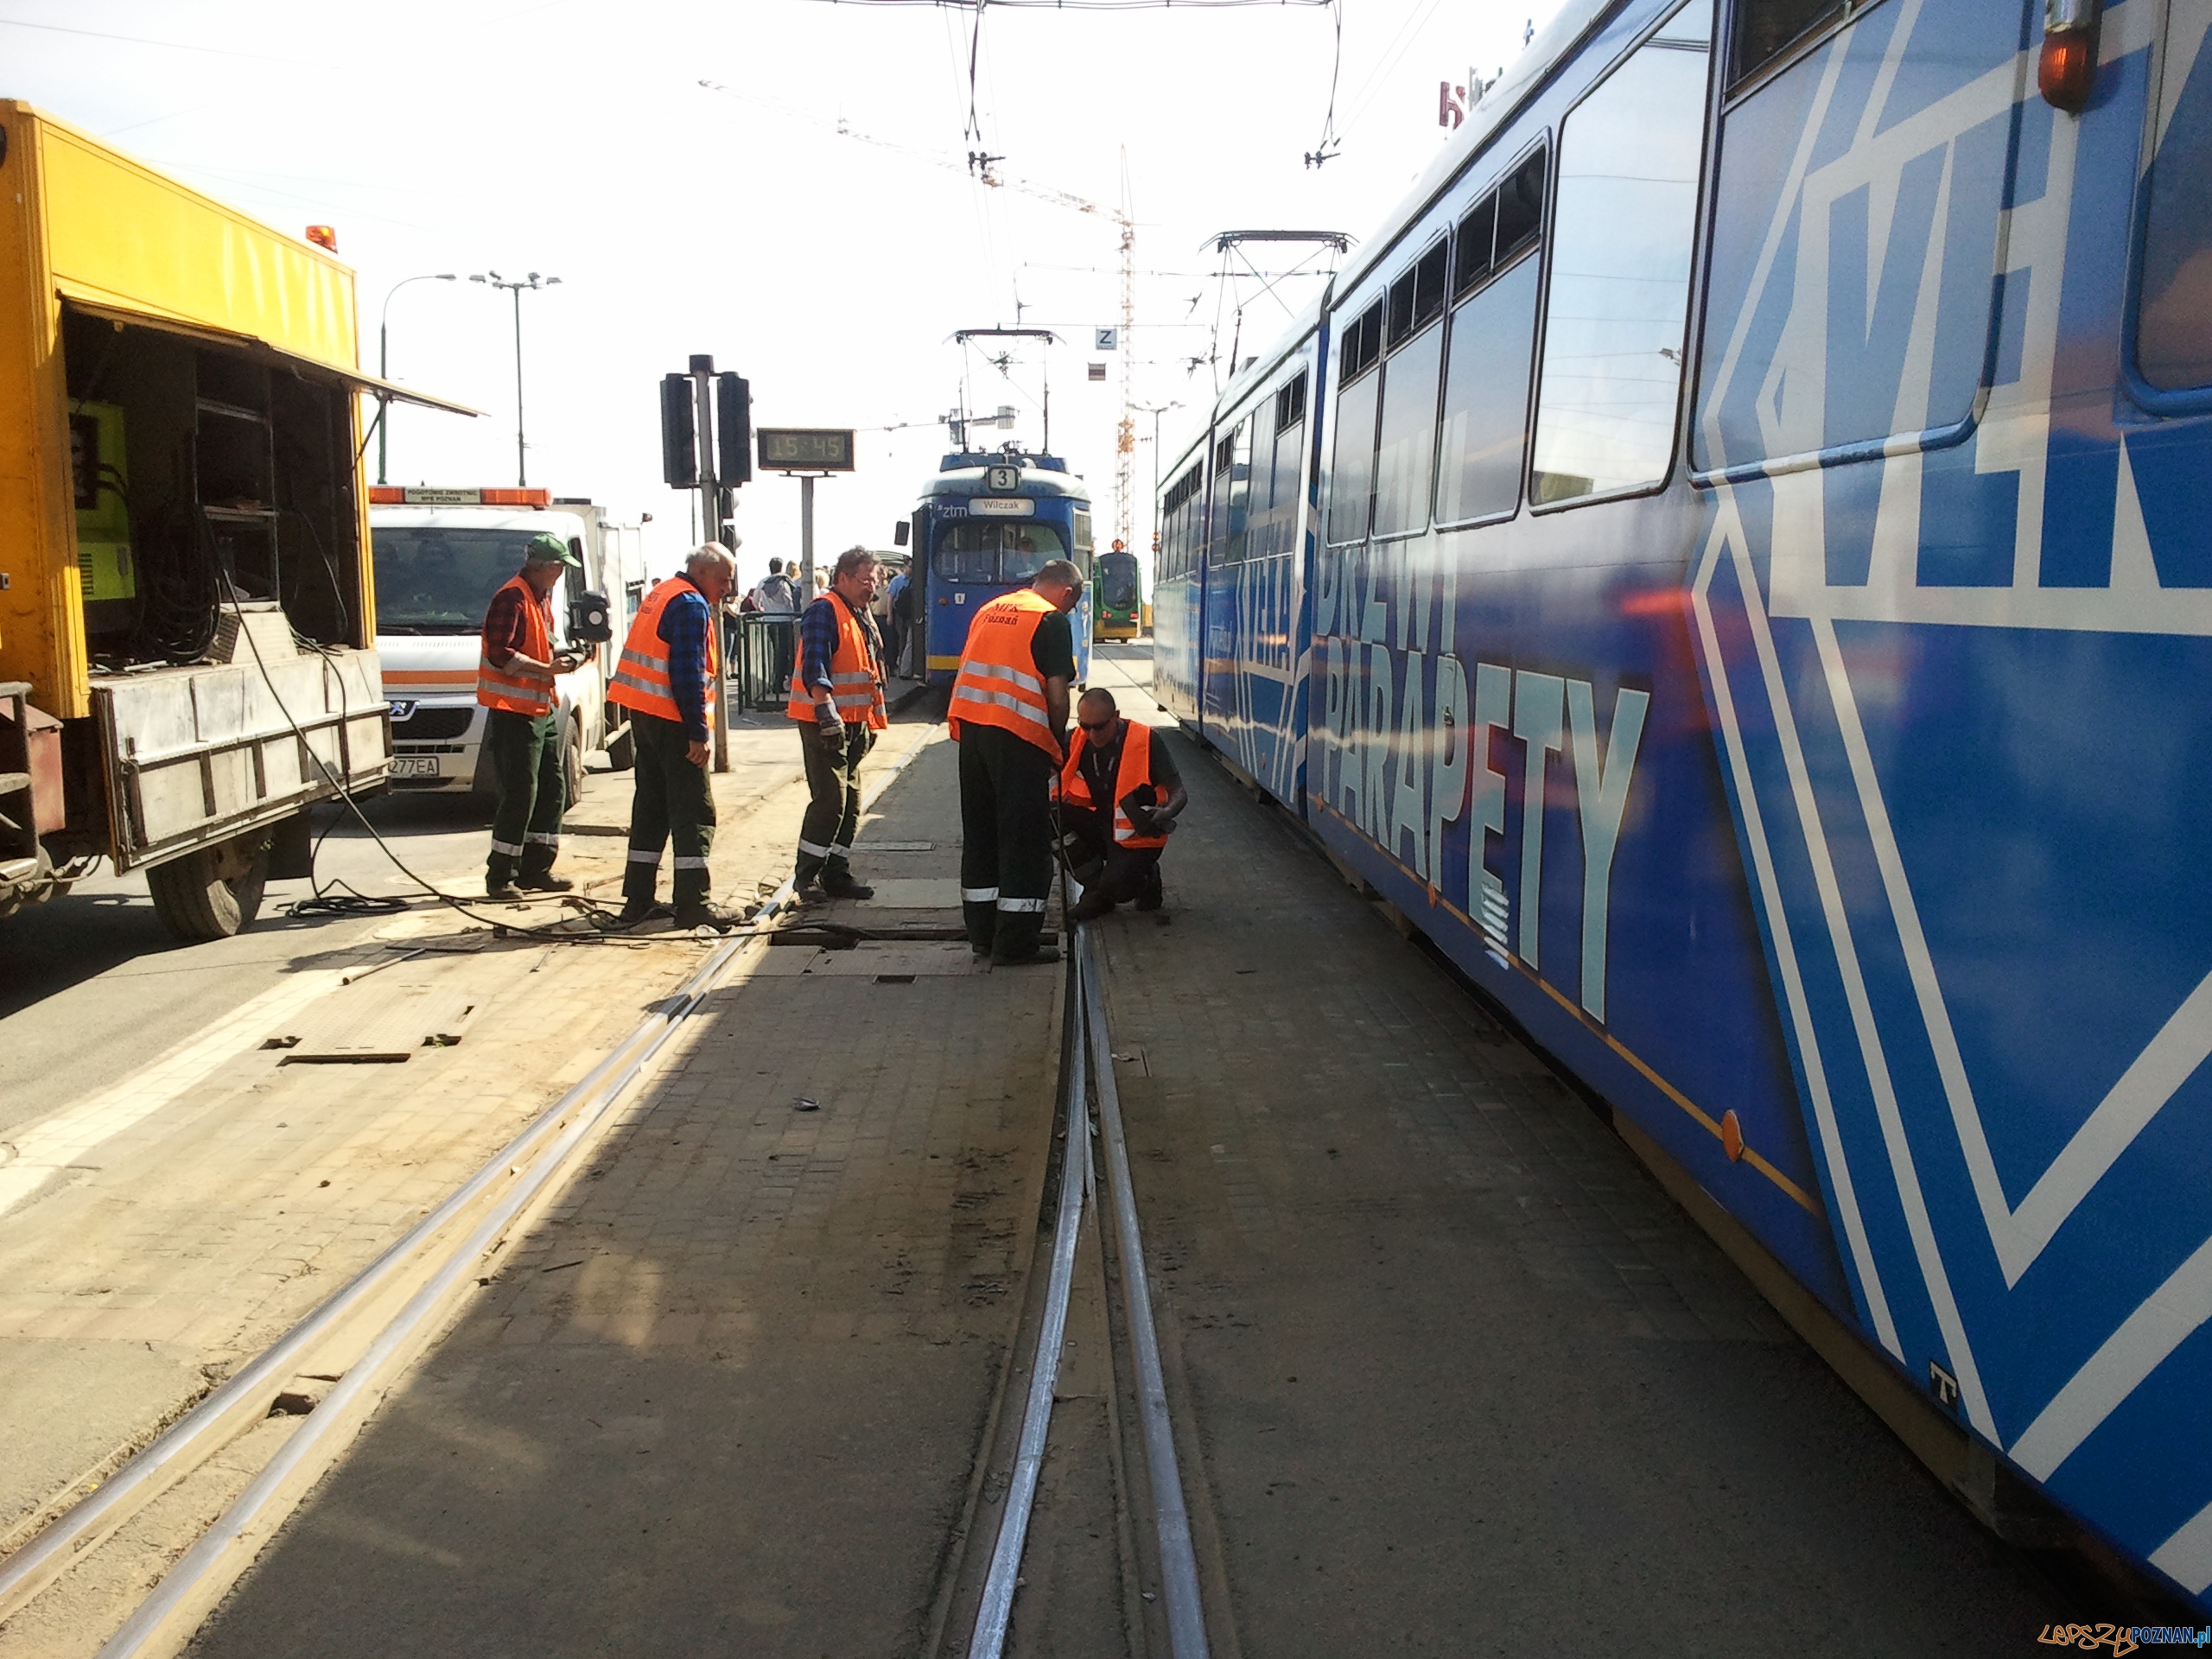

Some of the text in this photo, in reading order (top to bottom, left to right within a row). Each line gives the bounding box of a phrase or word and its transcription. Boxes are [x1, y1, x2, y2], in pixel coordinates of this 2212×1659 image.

[1099, 330, 1112, 344] Z
[997, 469, 1007, 486] 3
[943, 505, 968, 518] ztm
[983, 500, 1020, 510] Wilczak
[1323, 636, 1650, 1026] PARAPETY
